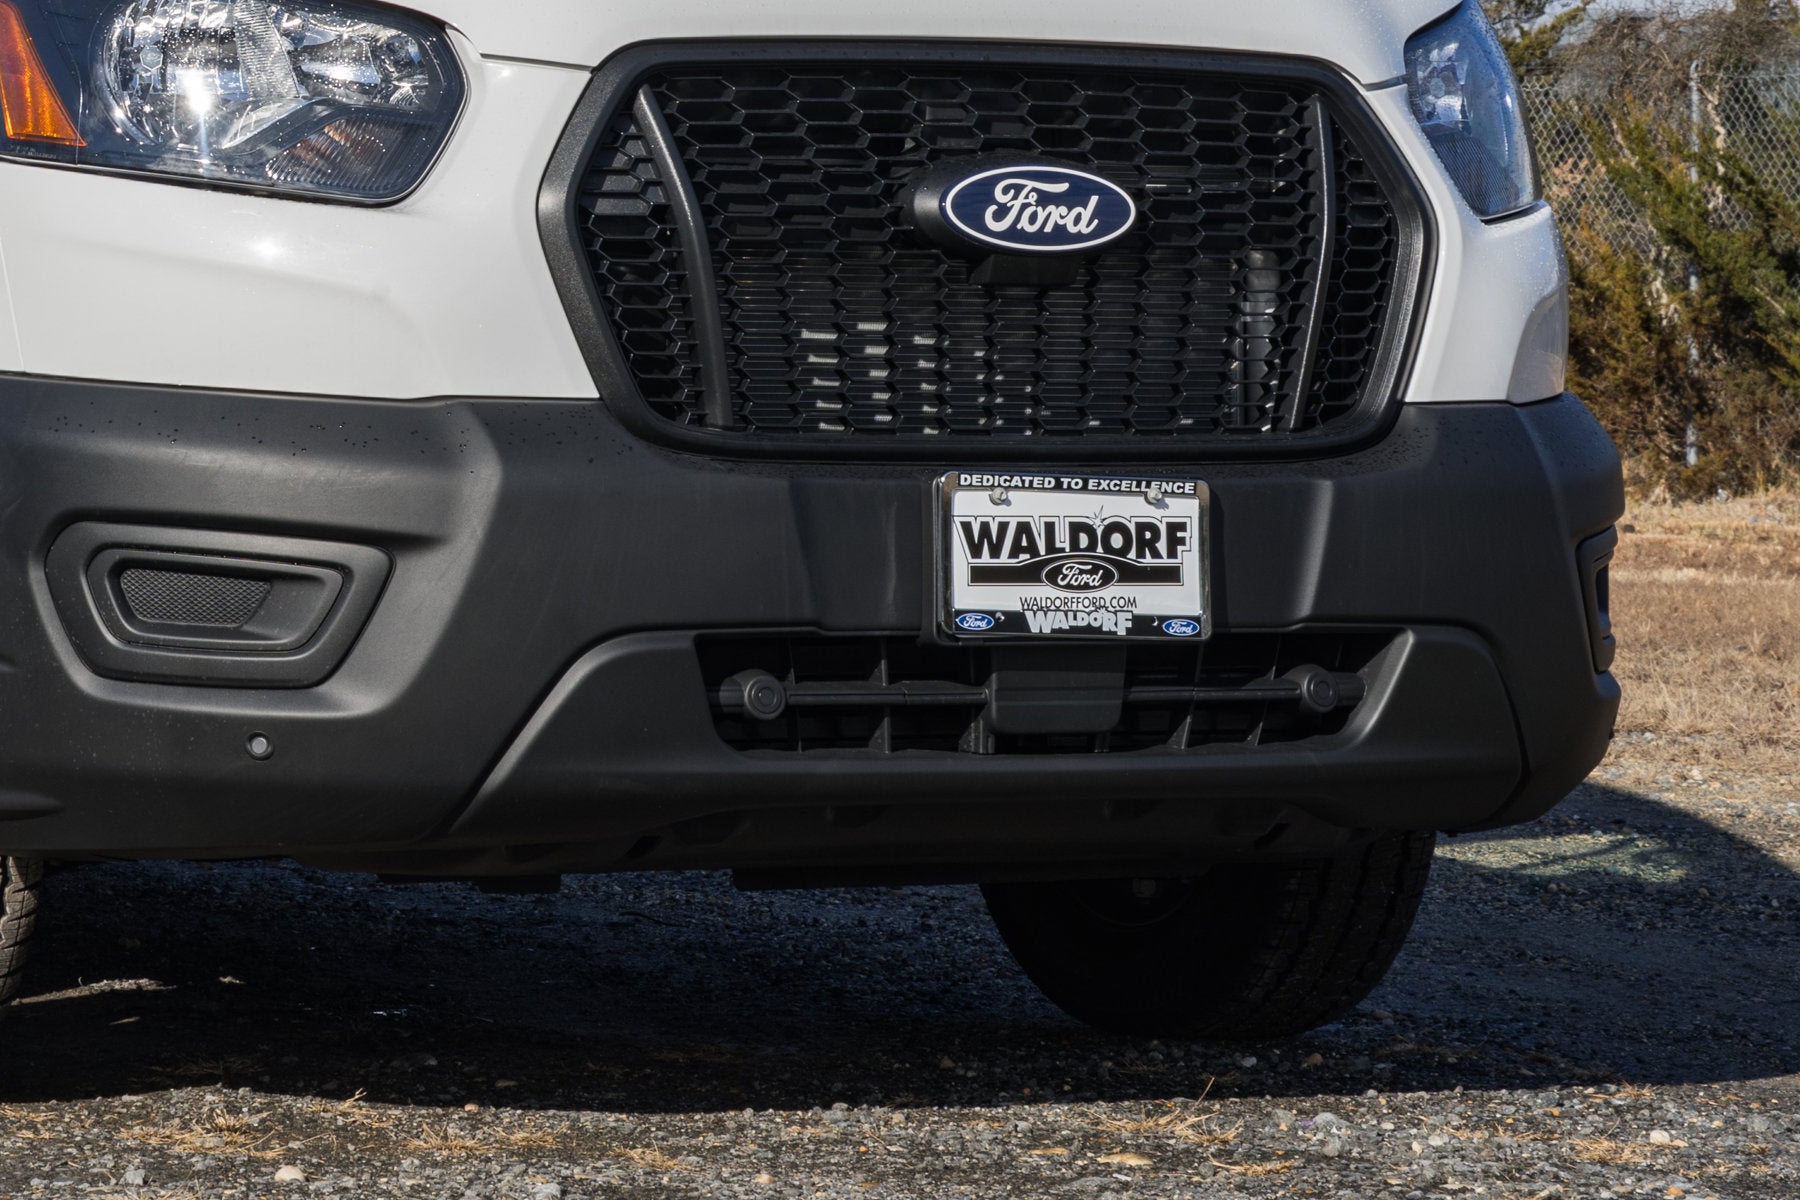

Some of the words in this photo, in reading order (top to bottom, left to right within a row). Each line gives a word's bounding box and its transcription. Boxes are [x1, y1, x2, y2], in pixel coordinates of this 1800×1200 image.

[985, 178, 1099, 234] Ford
[960, 473, 1056, 489] DEDICATED
[1062, 477, 1083, 490] TO
[1088, 478, 1196, 494] EXCELLENCE
[958, 520, 1188, 560] WALDORF
[1057, 562, 1104, 588] Ford
[1019, 596, 1137, 610] WALDORFFORD.COM
[963, 615, 989, 629] Ford
[1025, 610, 1133, 636] WALDORF
[1169, 620, 1193, 634] Ford
